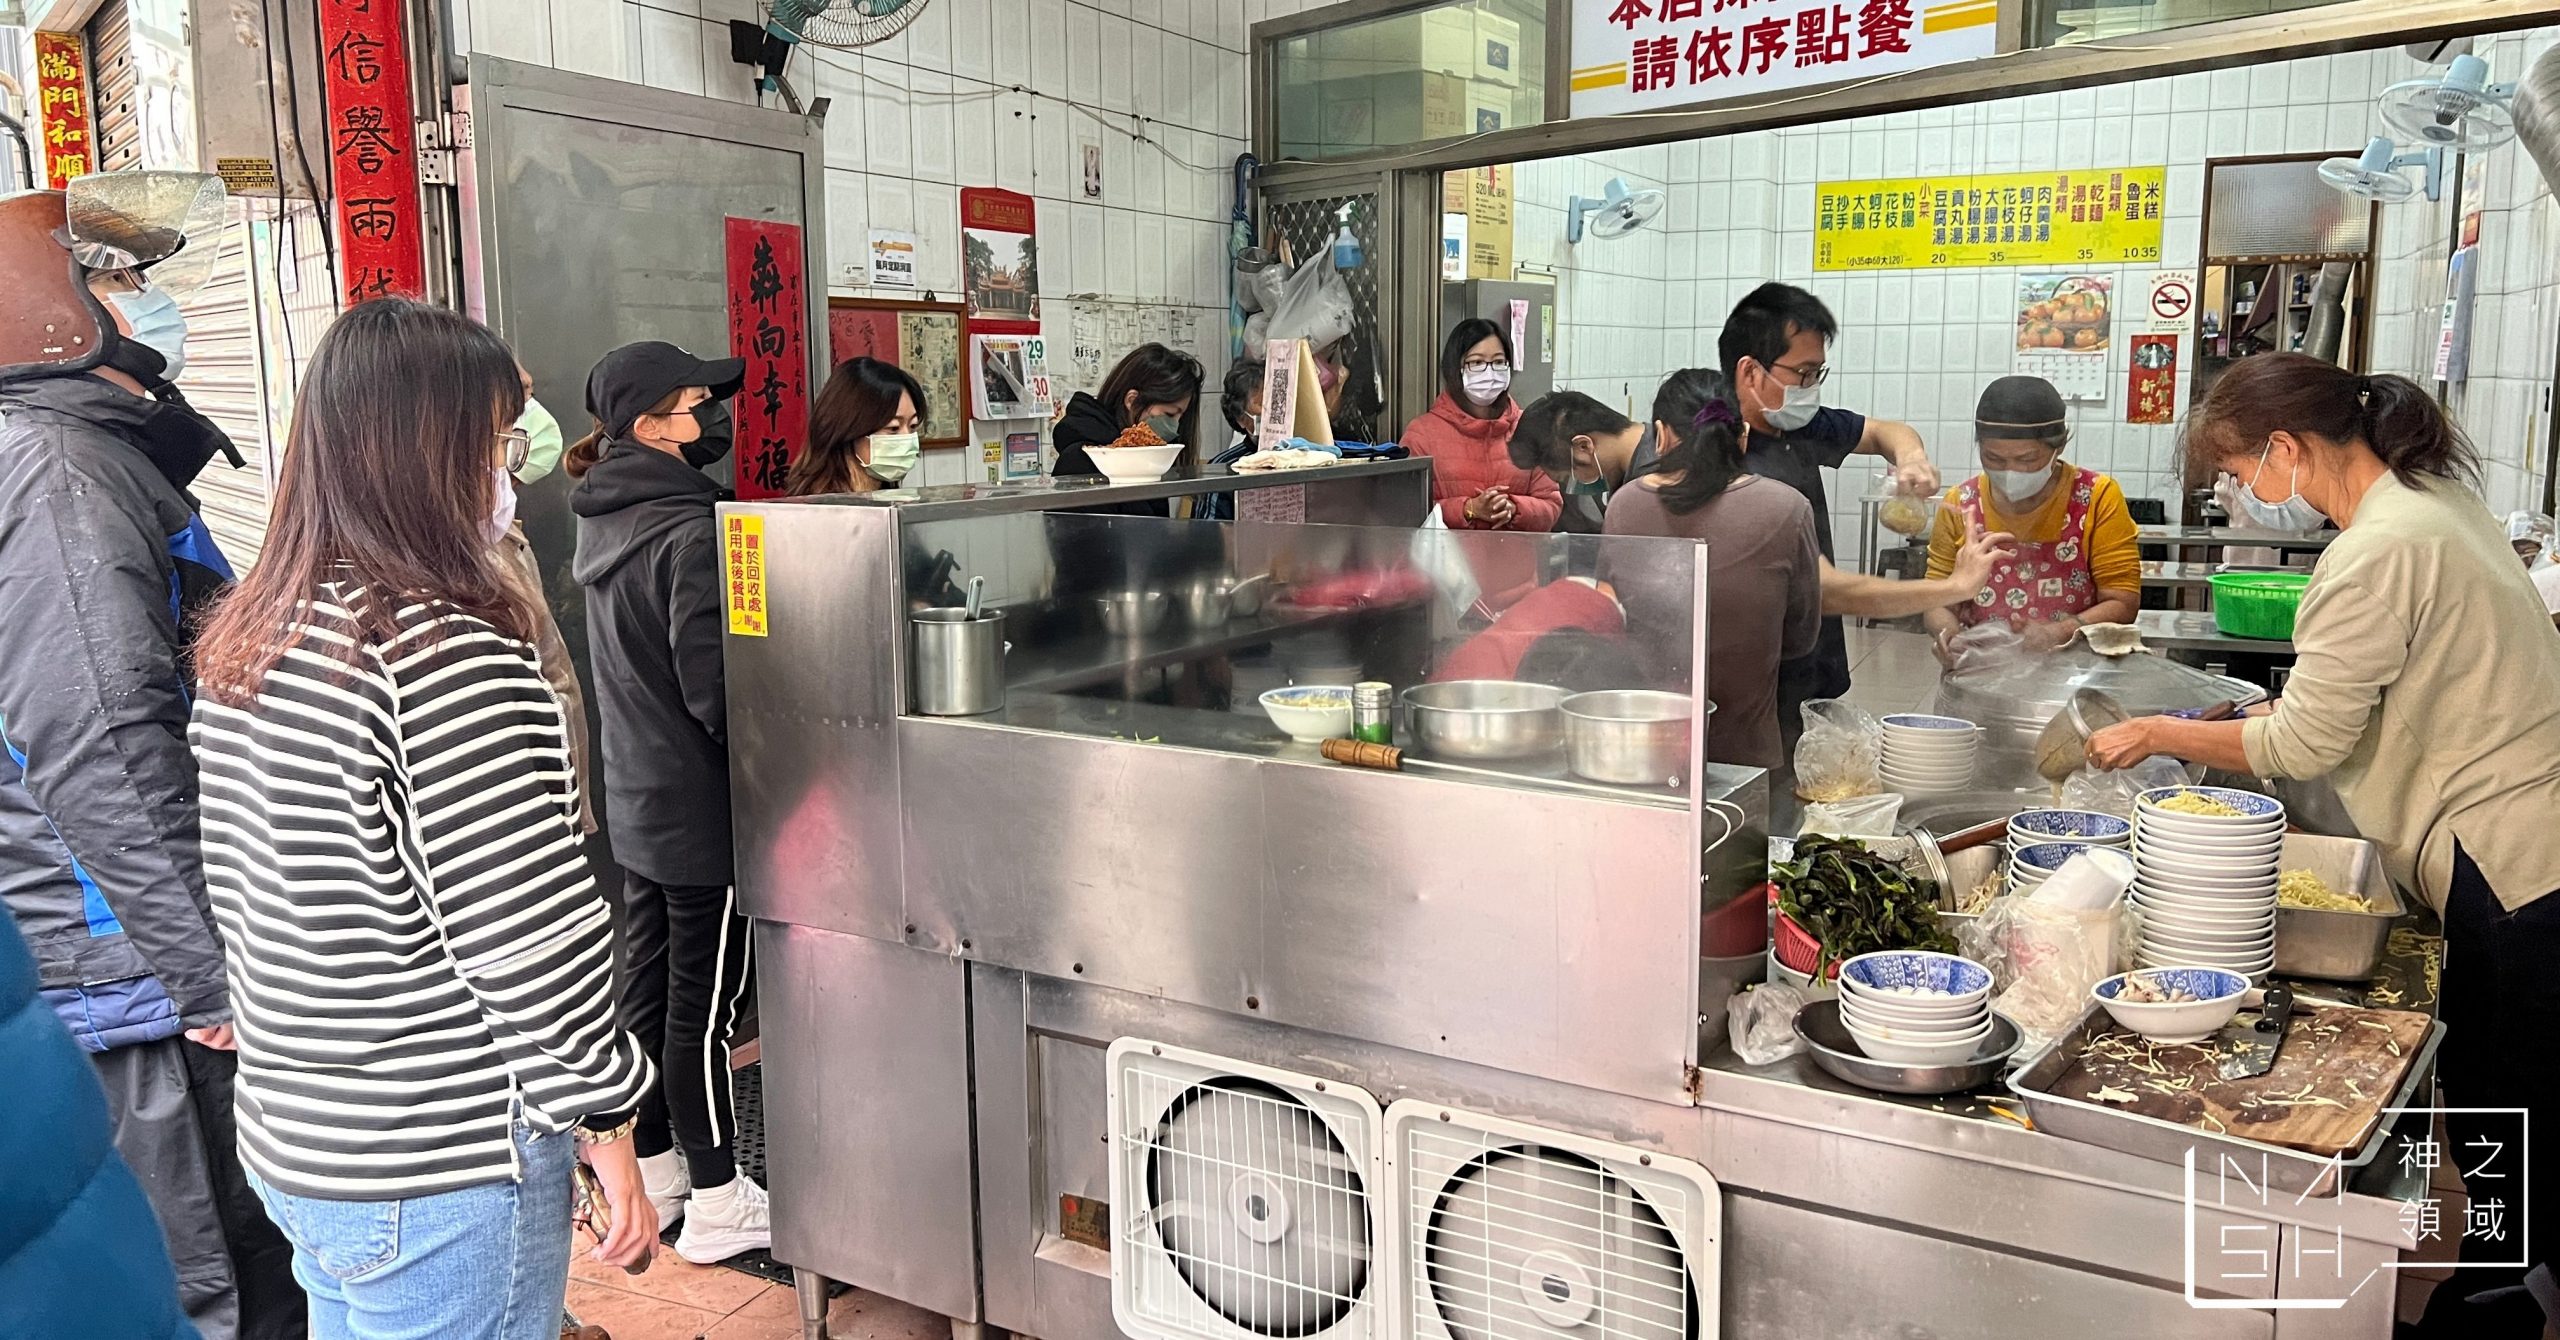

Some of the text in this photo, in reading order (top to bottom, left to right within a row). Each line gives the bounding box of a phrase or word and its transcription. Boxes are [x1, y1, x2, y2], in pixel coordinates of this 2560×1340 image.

[1632, 0, 1914, 93] 請依序點餐
[41, 51, 85, 181] 滿門和順
[1821, 195, 1834, 231] 豆腐
[1836, 195, 1849, 230] 抄手
[1852, 194, 1866, 230] 大腸
[1869, 193, 1883, 229] 蚵仔
[1886, 193, 1899, 228] 花枝
[1901, 192, 1915, 228] 粉腸
[1918, 182, 1931, 219] 小菜
[1932, 190, 1948, 245] 豆腐湯
[1949, 190, 1964, 245] 貢丸湯
[1966, 188, 1981, 244] 粉腸湯
[1983, 188, 1999, 243] 大腸湯
[2000, 188, 2017, 243] 花枝湯
[2018, 187, 2034, 243] 蚵仔湯
[2125, 182, 2140, 220] 魯蛋
[2144, 181, 2159, 220] 米糕
[1931, 253, 1946, 264] 20
[1989, 251, 2005, 262] 35
[2077, 249, 2093, 260] 35
[2123, 247, 2139, 258] 10
[2141, 246, 2158, 258] 35
[750, 234, 790, 491] 犇向幸福
[1027, 340, 1044, 359] 29
[1033, 377, 1049, 396] 30
[729, 518, 745, 611] 請用餐後餐具
[746, 534, 761, 612] 置於回收處
